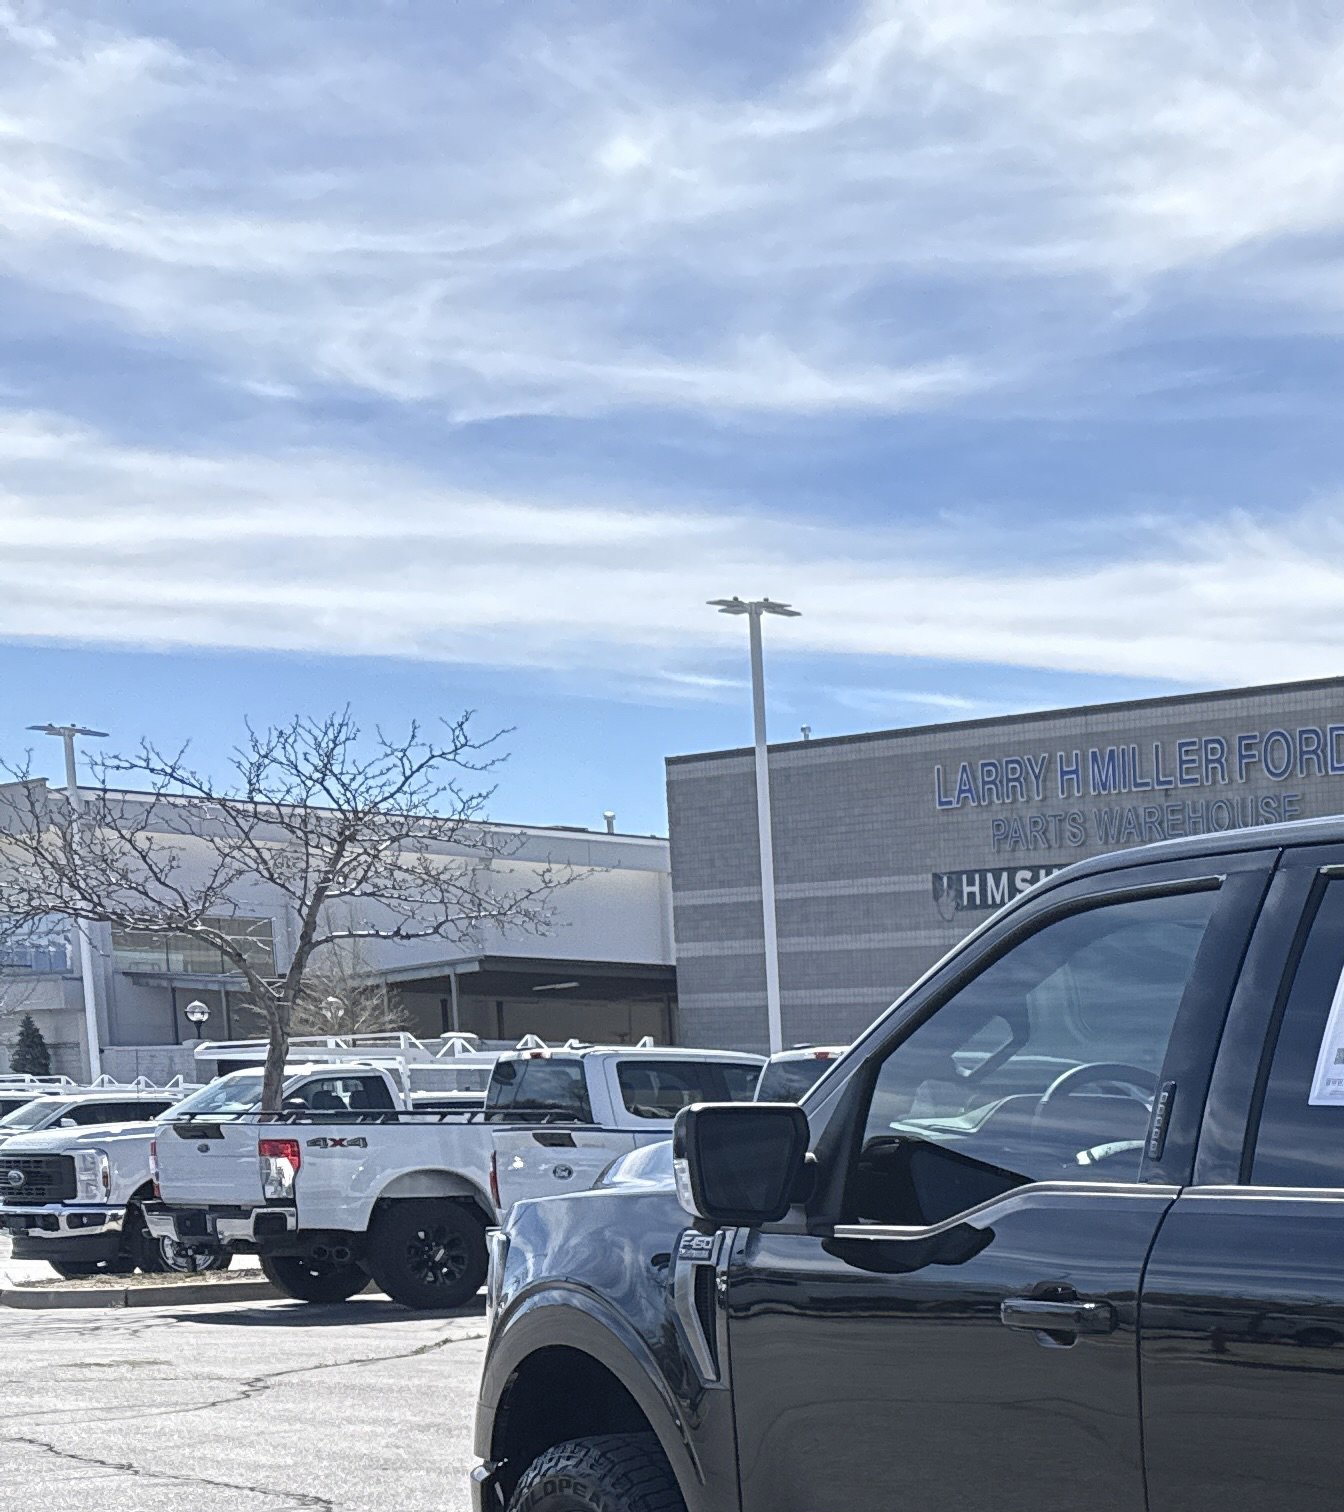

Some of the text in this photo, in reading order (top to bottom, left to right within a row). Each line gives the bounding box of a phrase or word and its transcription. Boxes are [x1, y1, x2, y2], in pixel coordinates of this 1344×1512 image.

[934, 753, 1048, 810] LARRY
[1058, 750, 1081, 798] H
[1089, 735, 1229, 796] MILLER
[992, 793, 1302, 851] PARTS WAREHOUSE
